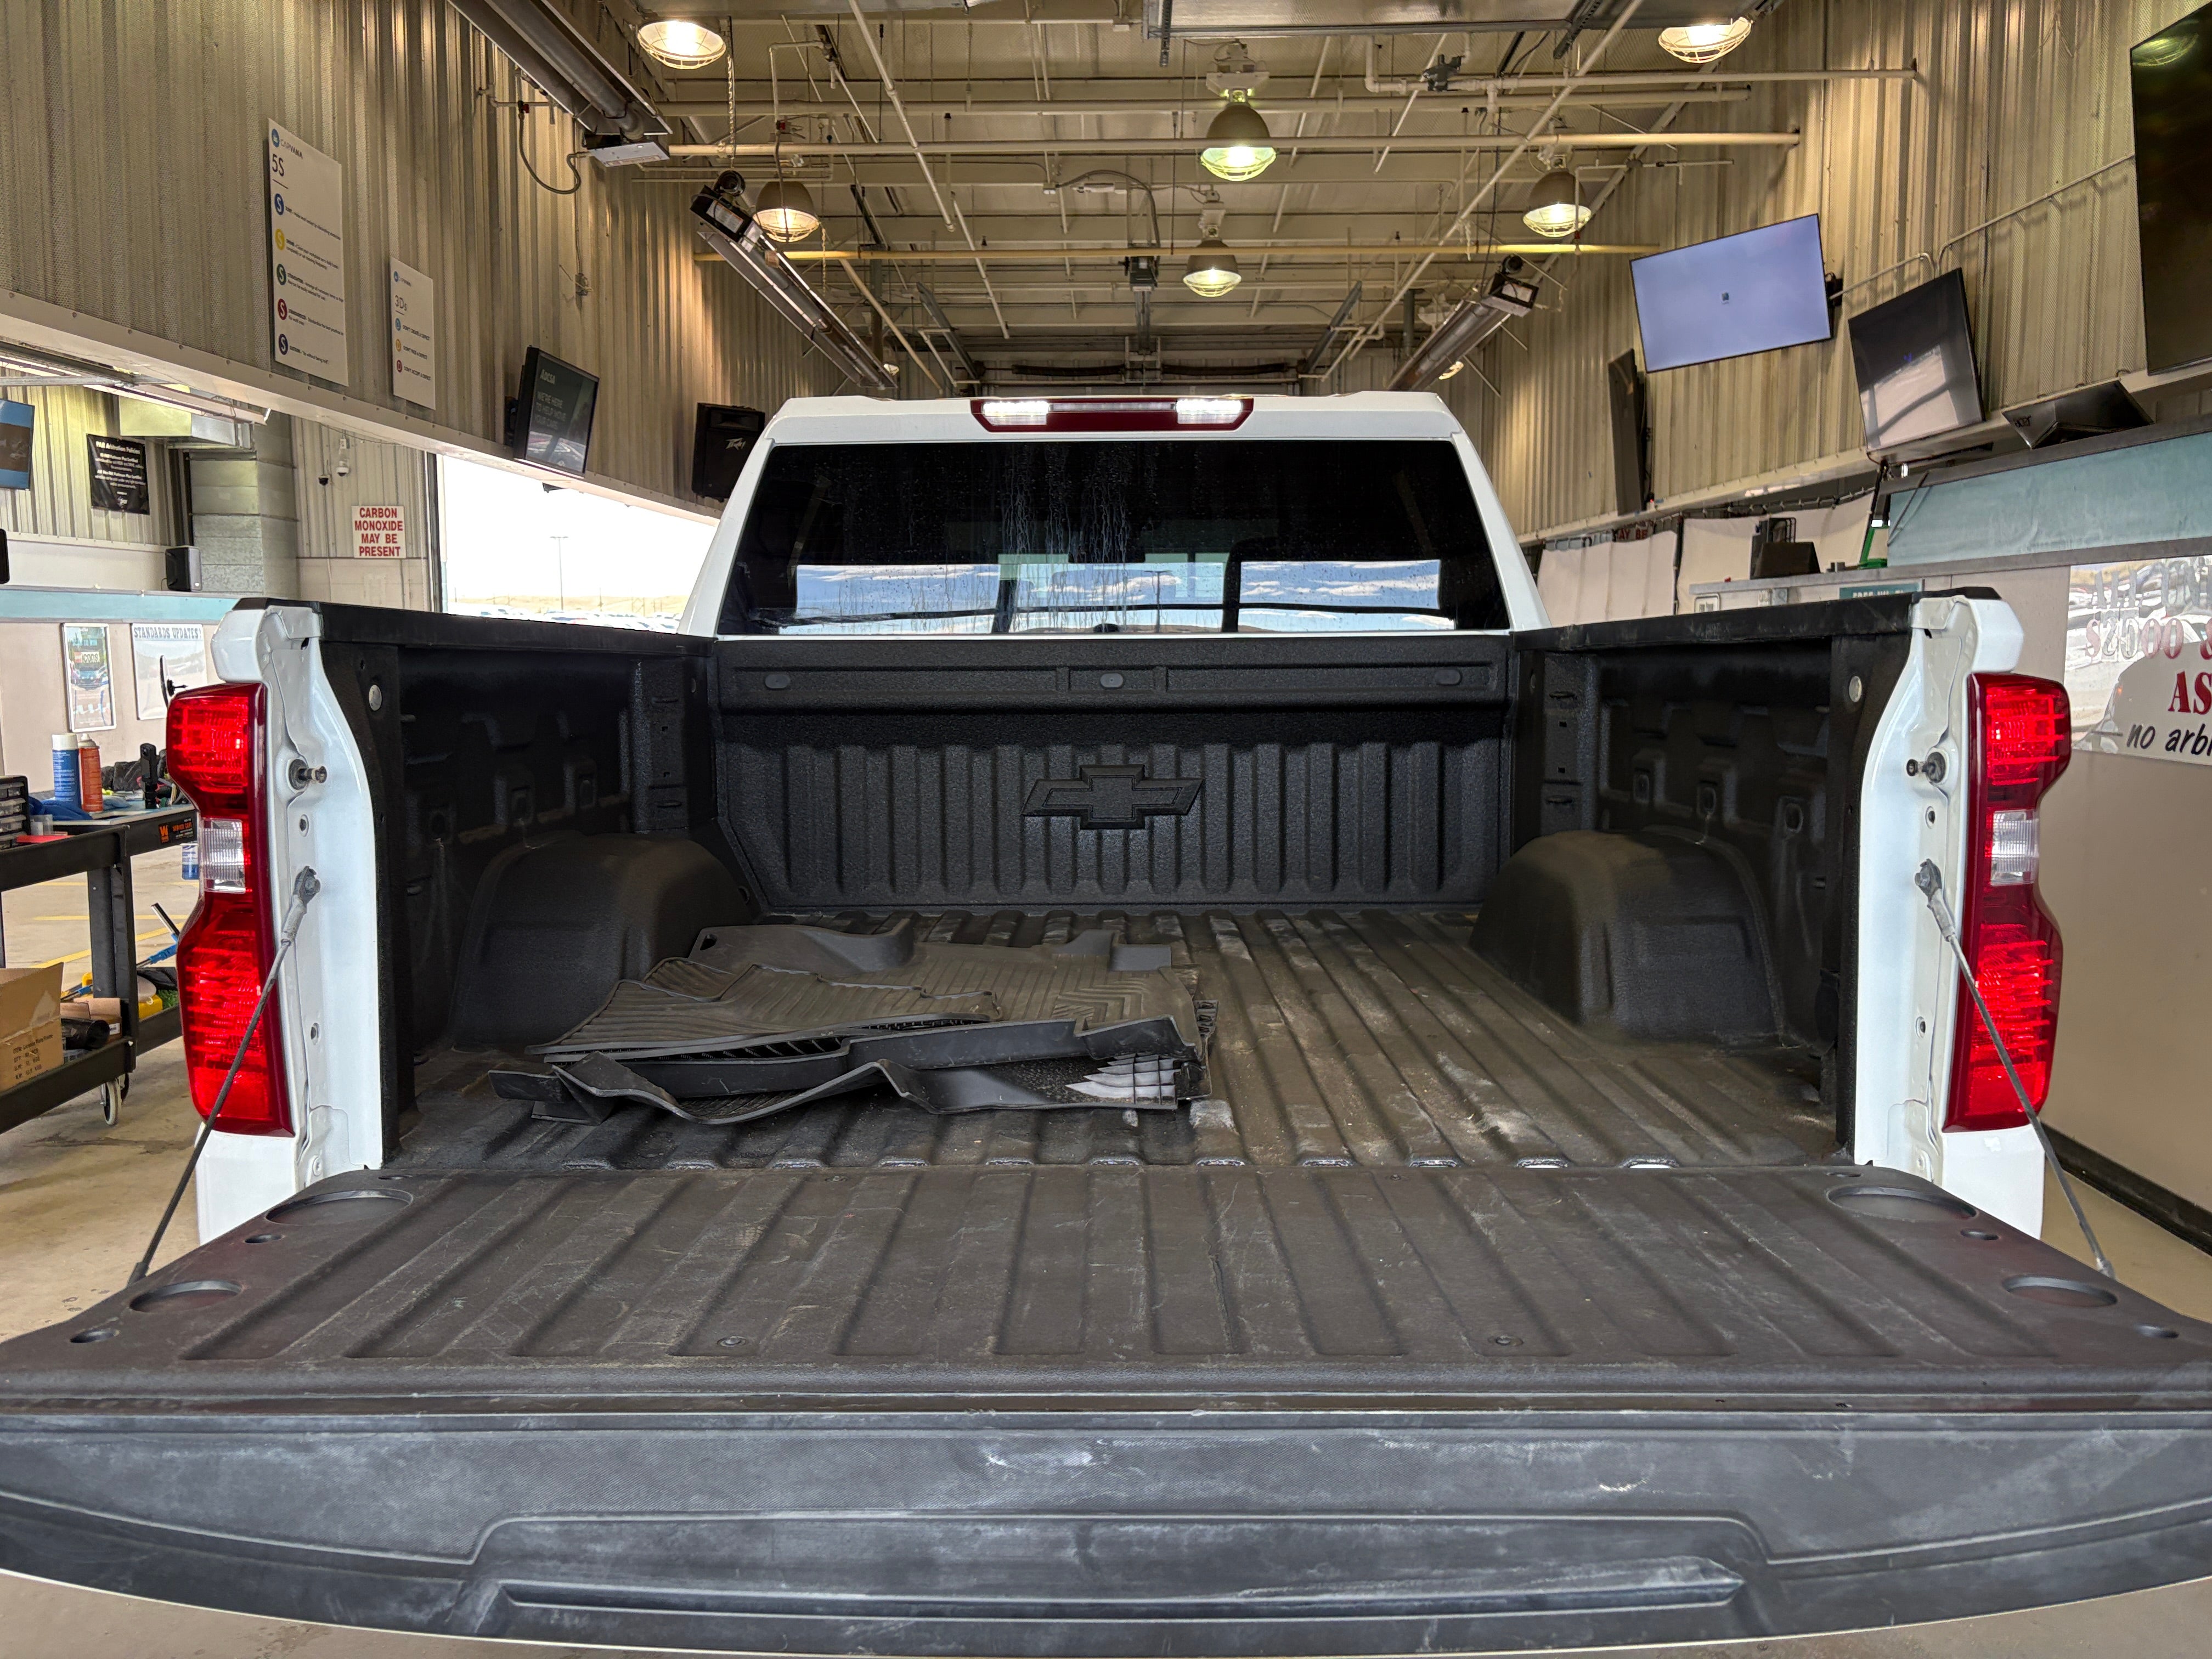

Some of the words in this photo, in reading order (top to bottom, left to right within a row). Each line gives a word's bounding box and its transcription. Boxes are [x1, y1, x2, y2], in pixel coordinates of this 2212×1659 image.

[272, 154, 284, 177] 5S
[359, 507, 397, 518] CARBON
[354, 520, 403, 531] MONOXIDE
[361, 533, 380, 544] MAY
[385, 533, 397, 544] BE
[1635, 528, 1648, 540] BE
[359, 546, 400, 556] PRESENT
[134, 627, 170, 638] STANDARDS
[172, 628, 202, 639] UPDATES!
[2086, 617, 2185, 662] $2000
[2168, 671, 2212, 715] AS
[2126, 724, 2156, 749] no
